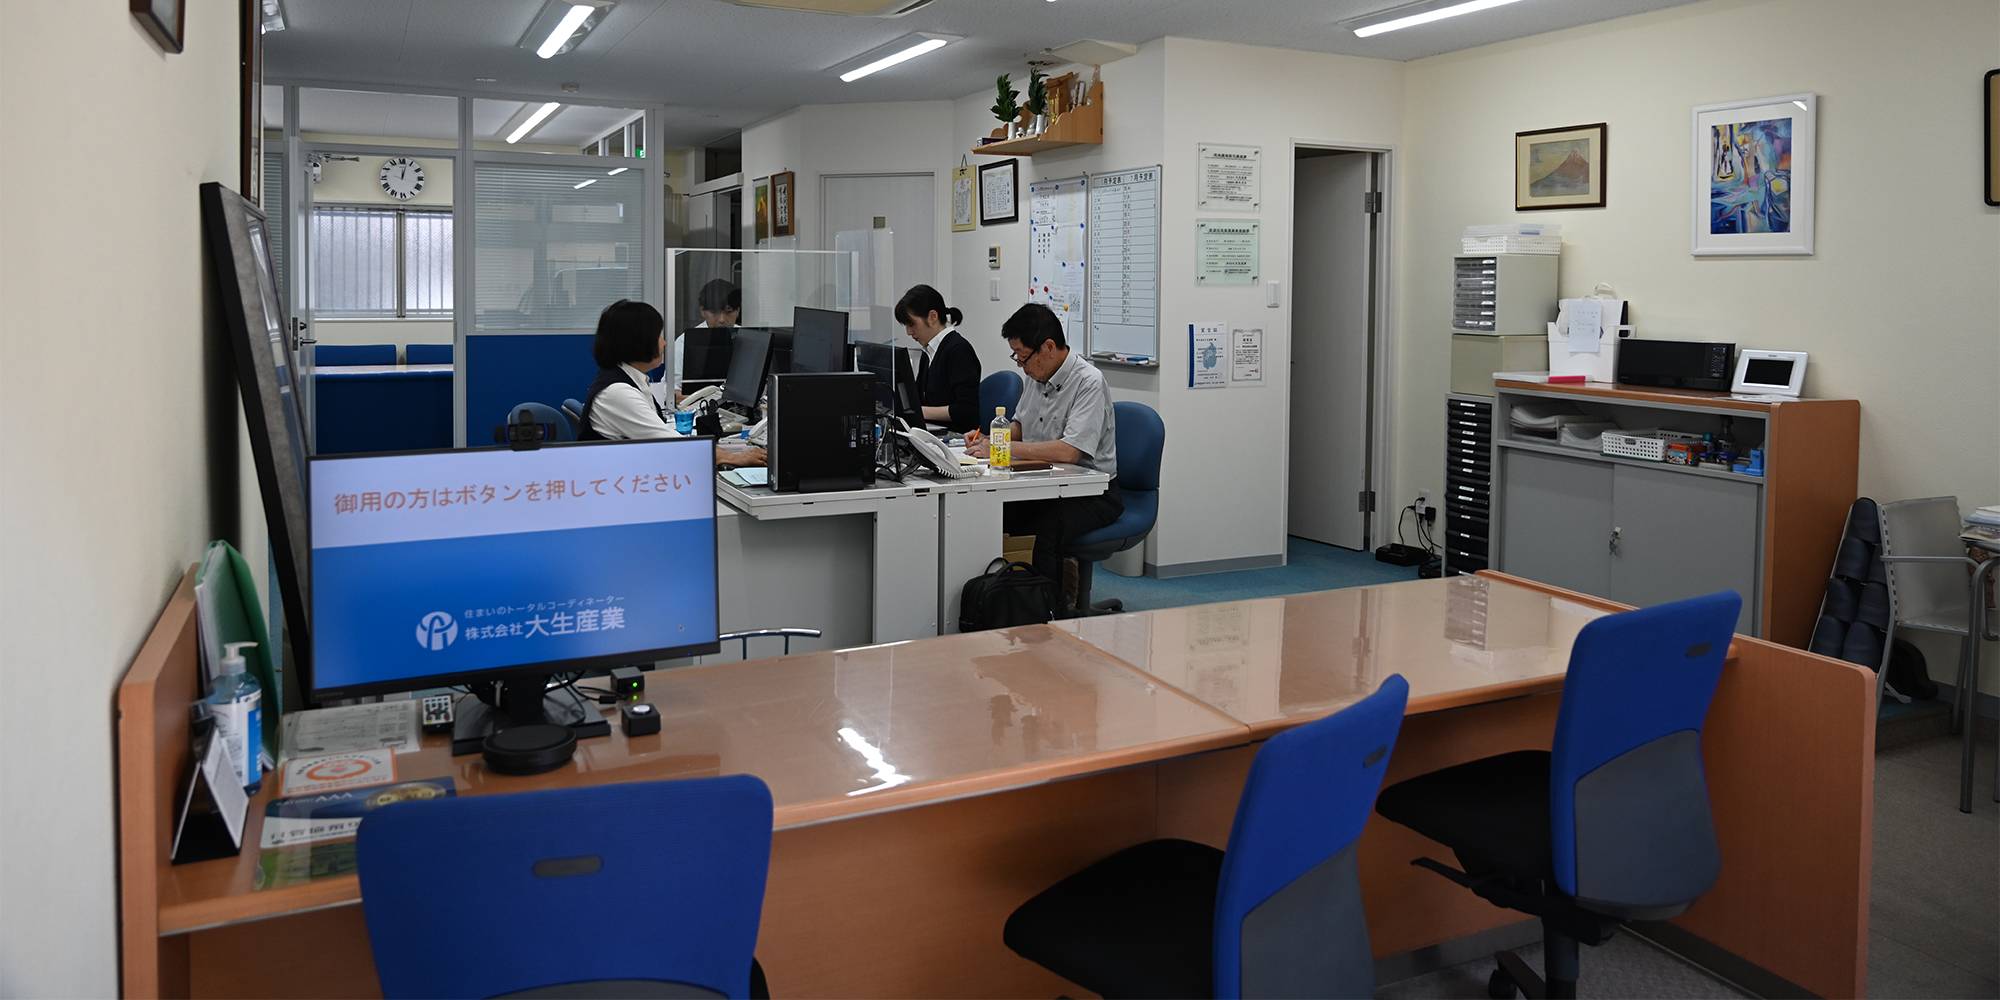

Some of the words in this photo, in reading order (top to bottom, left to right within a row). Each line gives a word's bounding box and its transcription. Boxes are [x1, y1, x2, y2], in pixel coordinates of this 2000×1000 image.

[333, 473, 692, 515] 御用の方はボタンを押してください
[464, 595, 625, 618] 住まいのトータルコーディネーター
[465, 607, 625, 640] 株式会社大生産業
